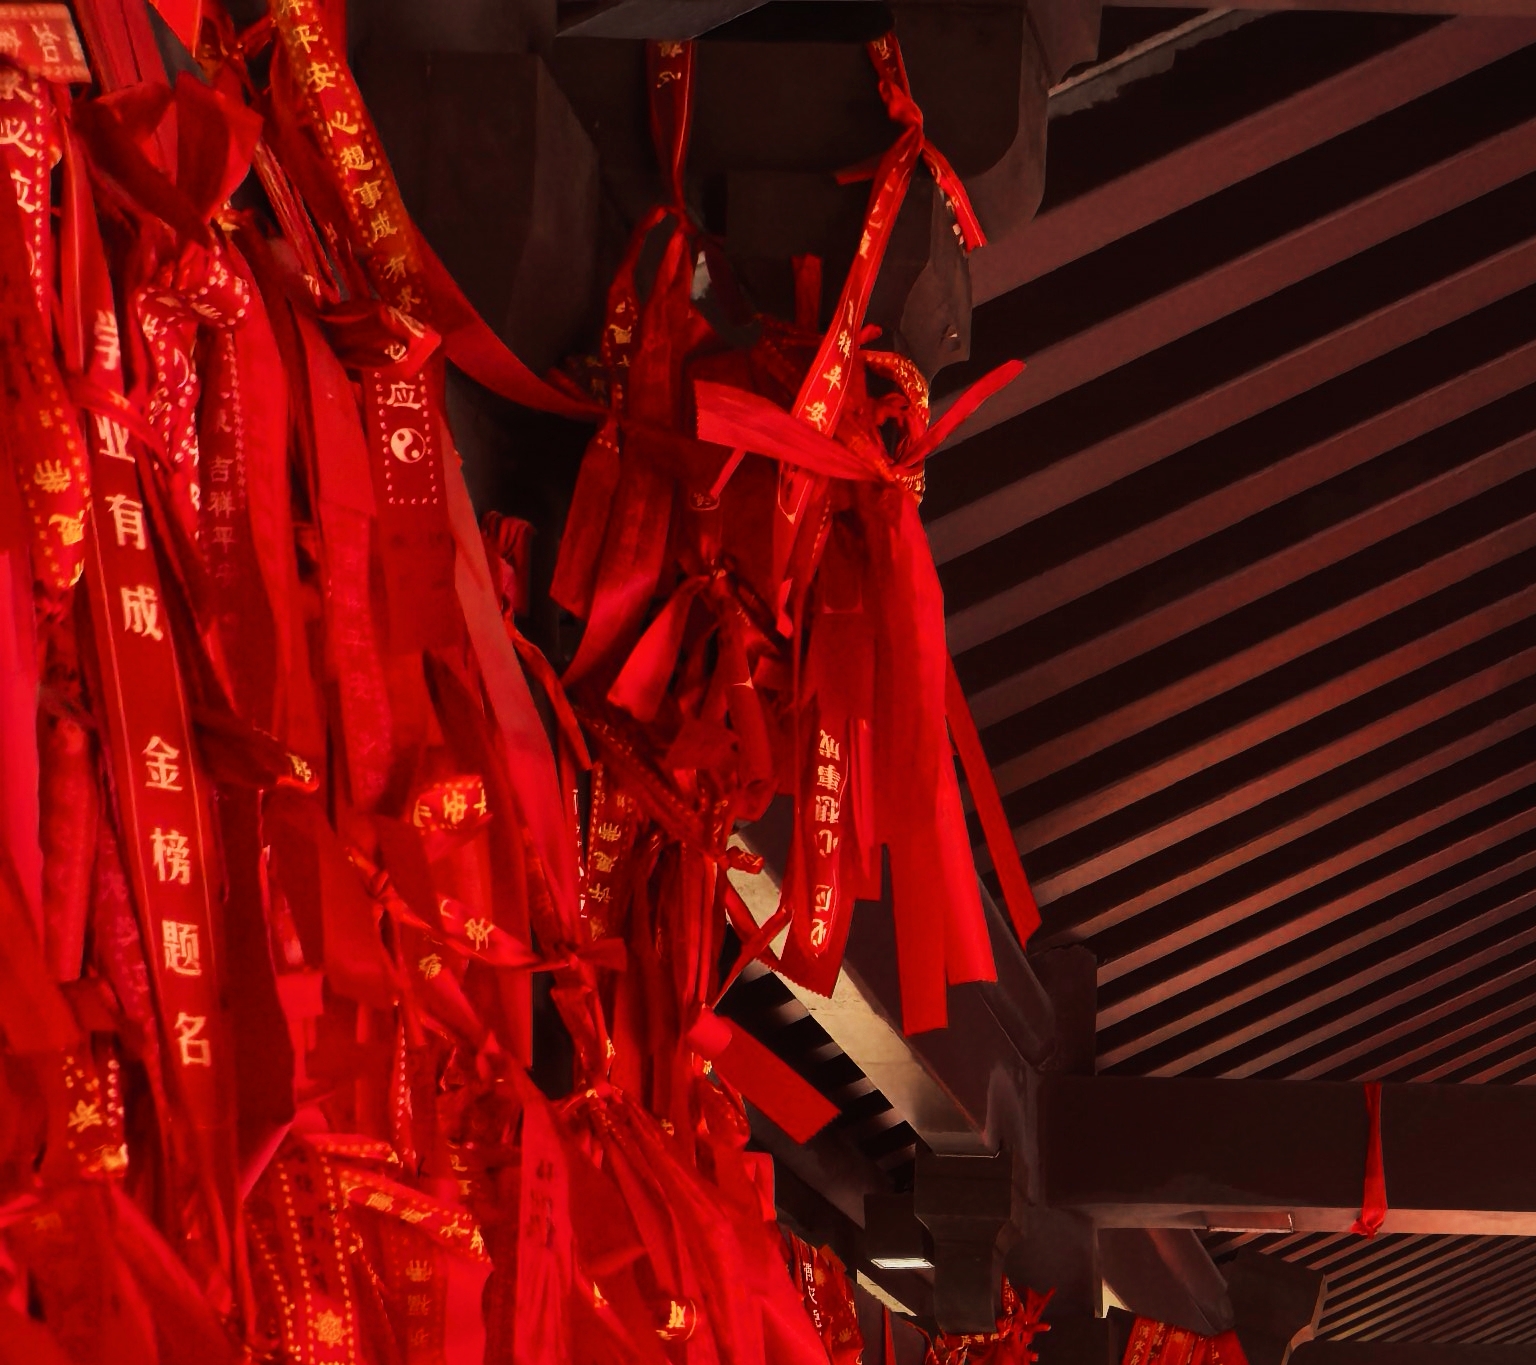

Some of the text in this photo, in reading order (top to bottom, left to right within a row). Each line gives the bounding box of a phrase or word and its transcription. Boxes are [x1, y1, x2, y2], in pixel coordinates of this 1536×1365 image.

[326, 111, 398, 246] 心想事成
[814, 729, 841, 859] 心想事成
[142, 734, 212, 1068] 金榜题名
